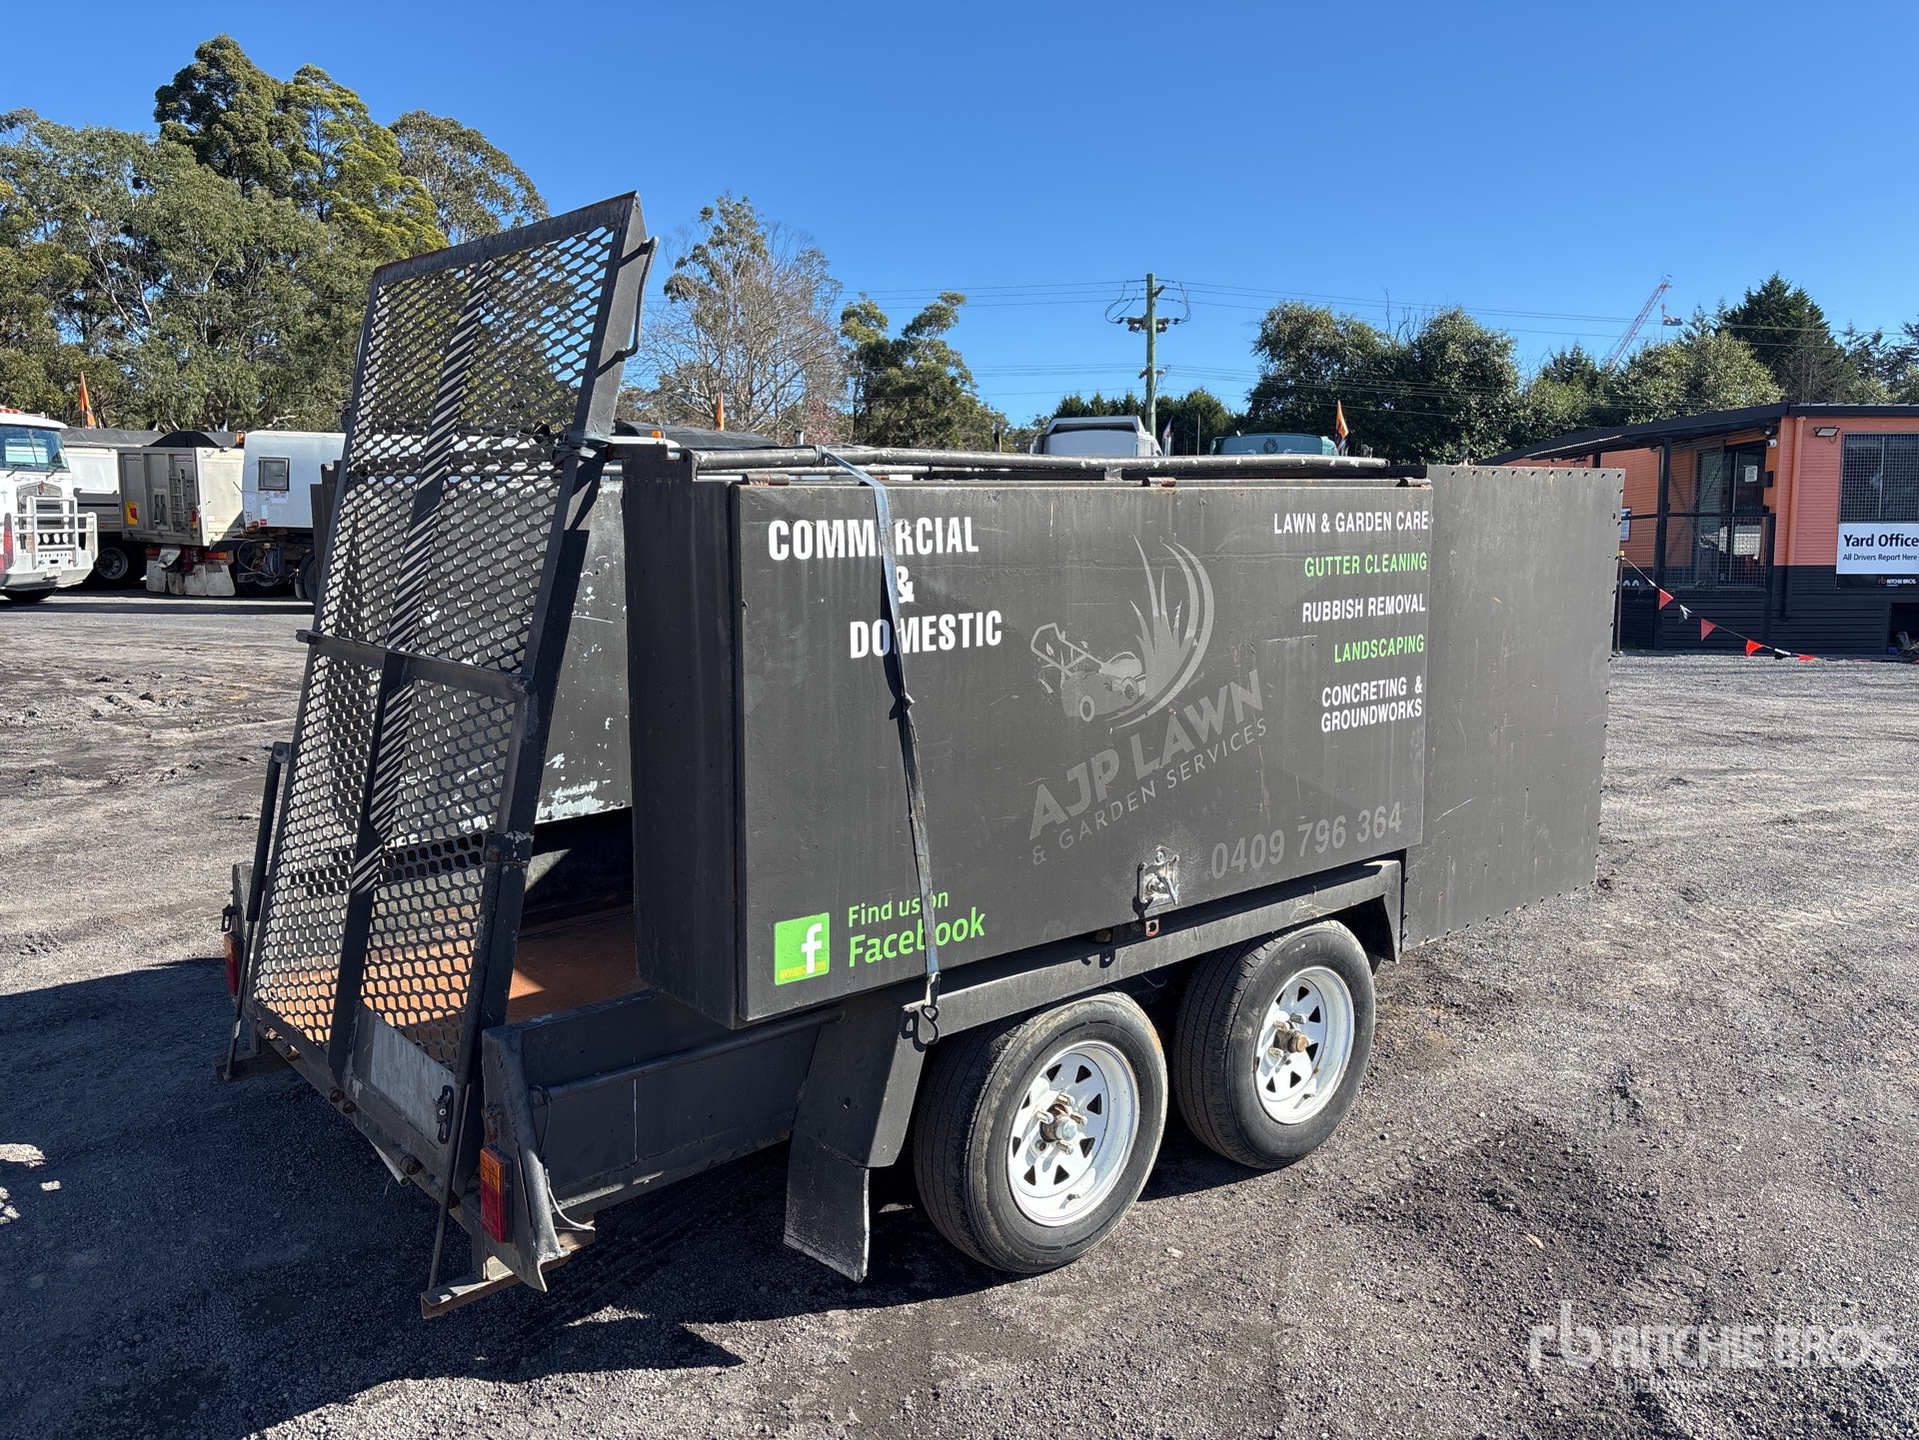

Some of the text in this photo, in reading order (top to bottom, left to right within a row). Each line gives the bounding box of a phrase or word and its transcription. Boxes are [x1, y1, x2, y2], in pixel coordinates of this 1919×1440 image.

[768, 516, 979, 561] COMMRCIAL
[1274, 510, 1429, 534] LAWN & GARDEN CARE
[1843, 533, 1919, 547] Yard Office
[1304, 552, 1427, 577] GUTTER CLEANING
[1843, 553, 1918, 563] All Drivers Report Here
[896, 565, 915, 604] &
[1302, 593, 1426, 623] RUBBISH REMOVAL
[850, 610, 1002, 659] DOMESTIC
[1334, 634, 1425, 663] LANDSCAPING
[1322, 675, 1423, 707] CONCRETING &
[1321, 698, 1422, 733] GROUNDWORKS
[1029, 669, 1264, 841] AJP LAWN
[1033, 718, 1267, 867] & GARDEN SERVICES
[1211, 802, 1402, 880] 0409 796 364
[848, 901, 893, 928] Find
[899, 897, 920, 917] us
[801, 922, 823, 974] f
